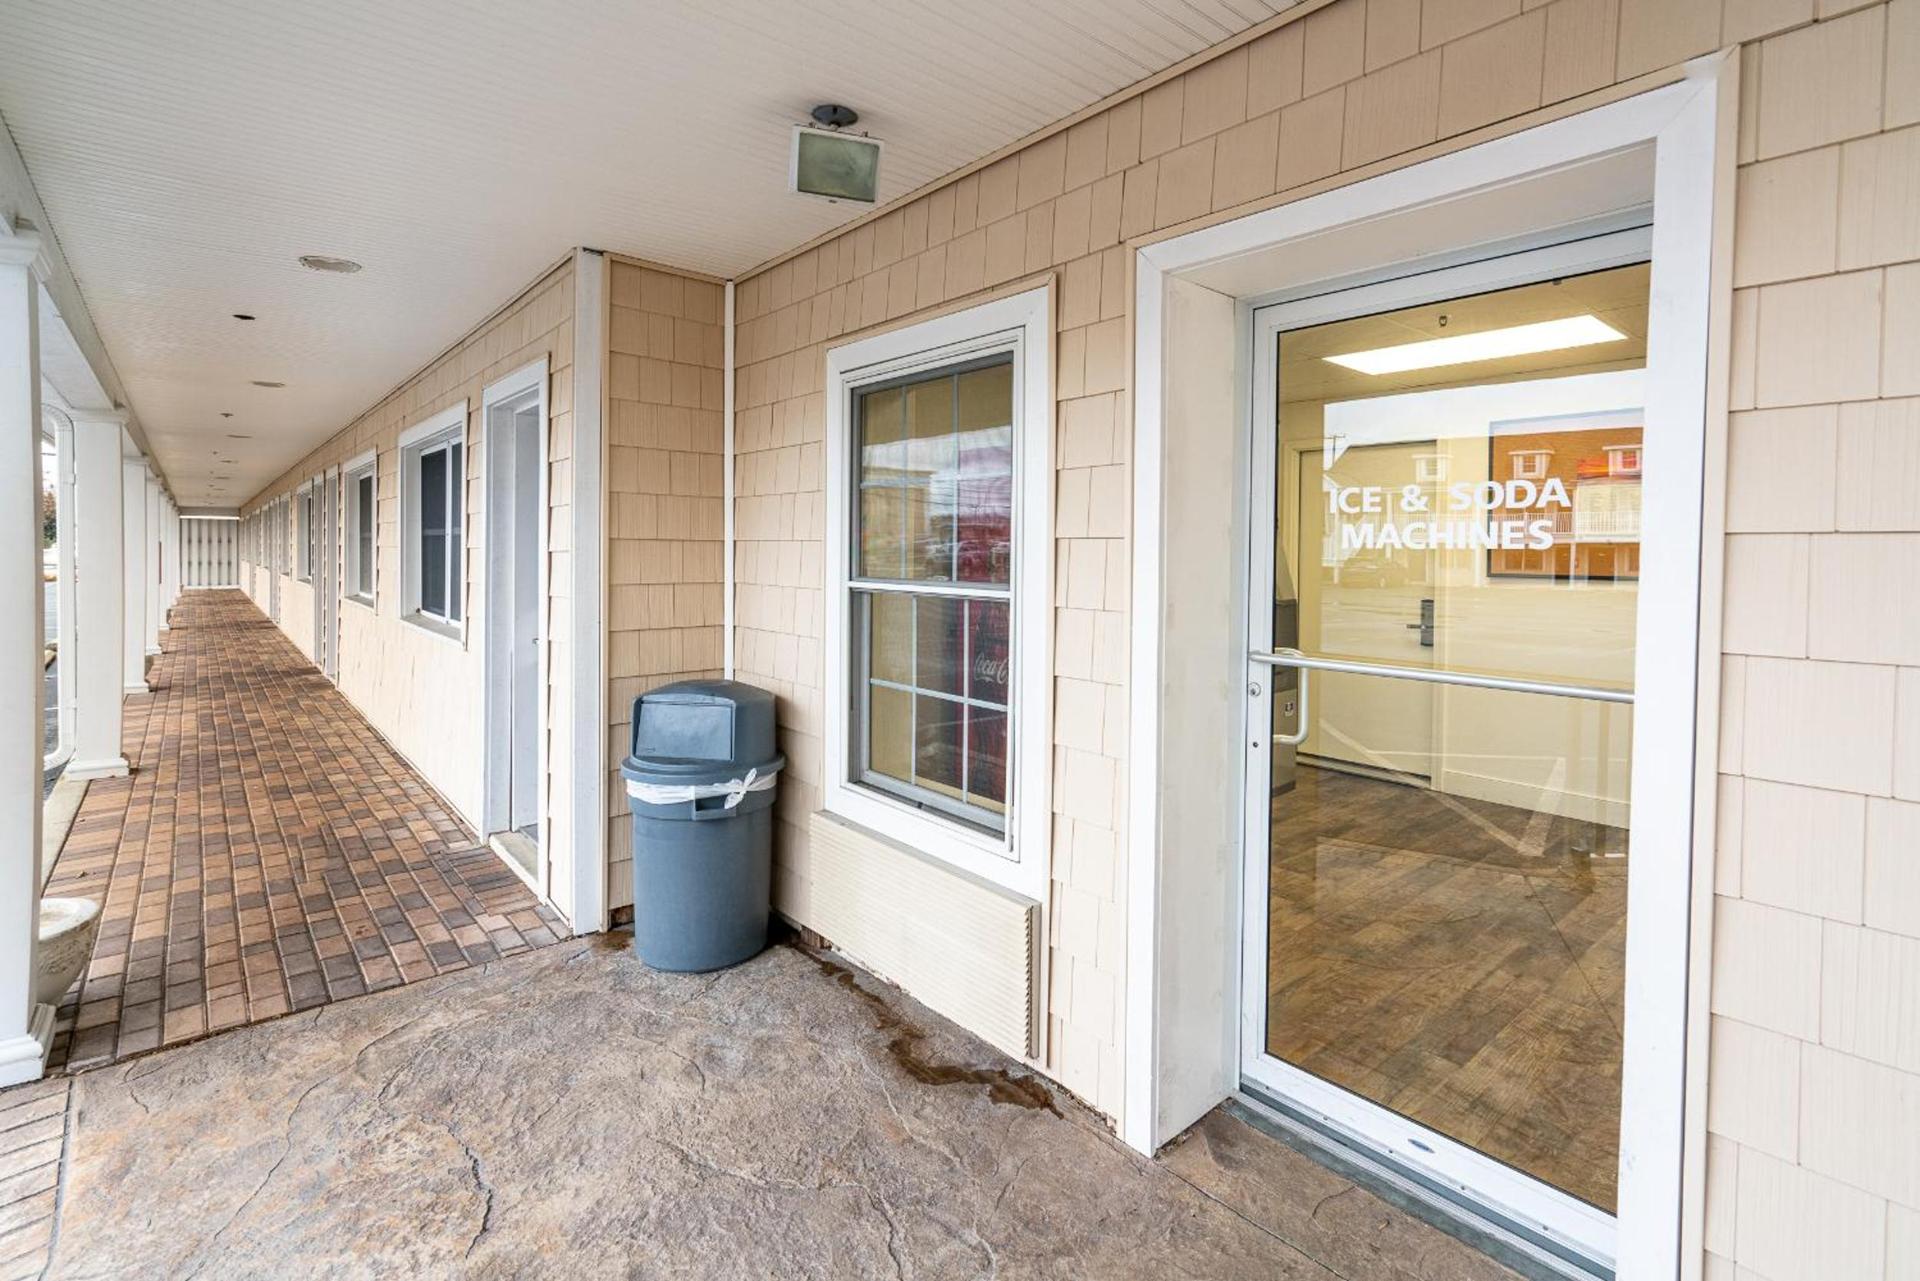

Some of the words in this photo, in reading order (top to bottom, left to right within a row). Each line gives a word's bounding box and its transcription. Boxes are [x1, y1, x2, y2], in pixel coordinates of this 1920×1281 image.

[1329, 487, 1382, 513] ICE
[1401, 484, 1428, 512] &
[1449, 478, 1571, 510] SODA
[1342, 519, 1554, 550] MACHINES
